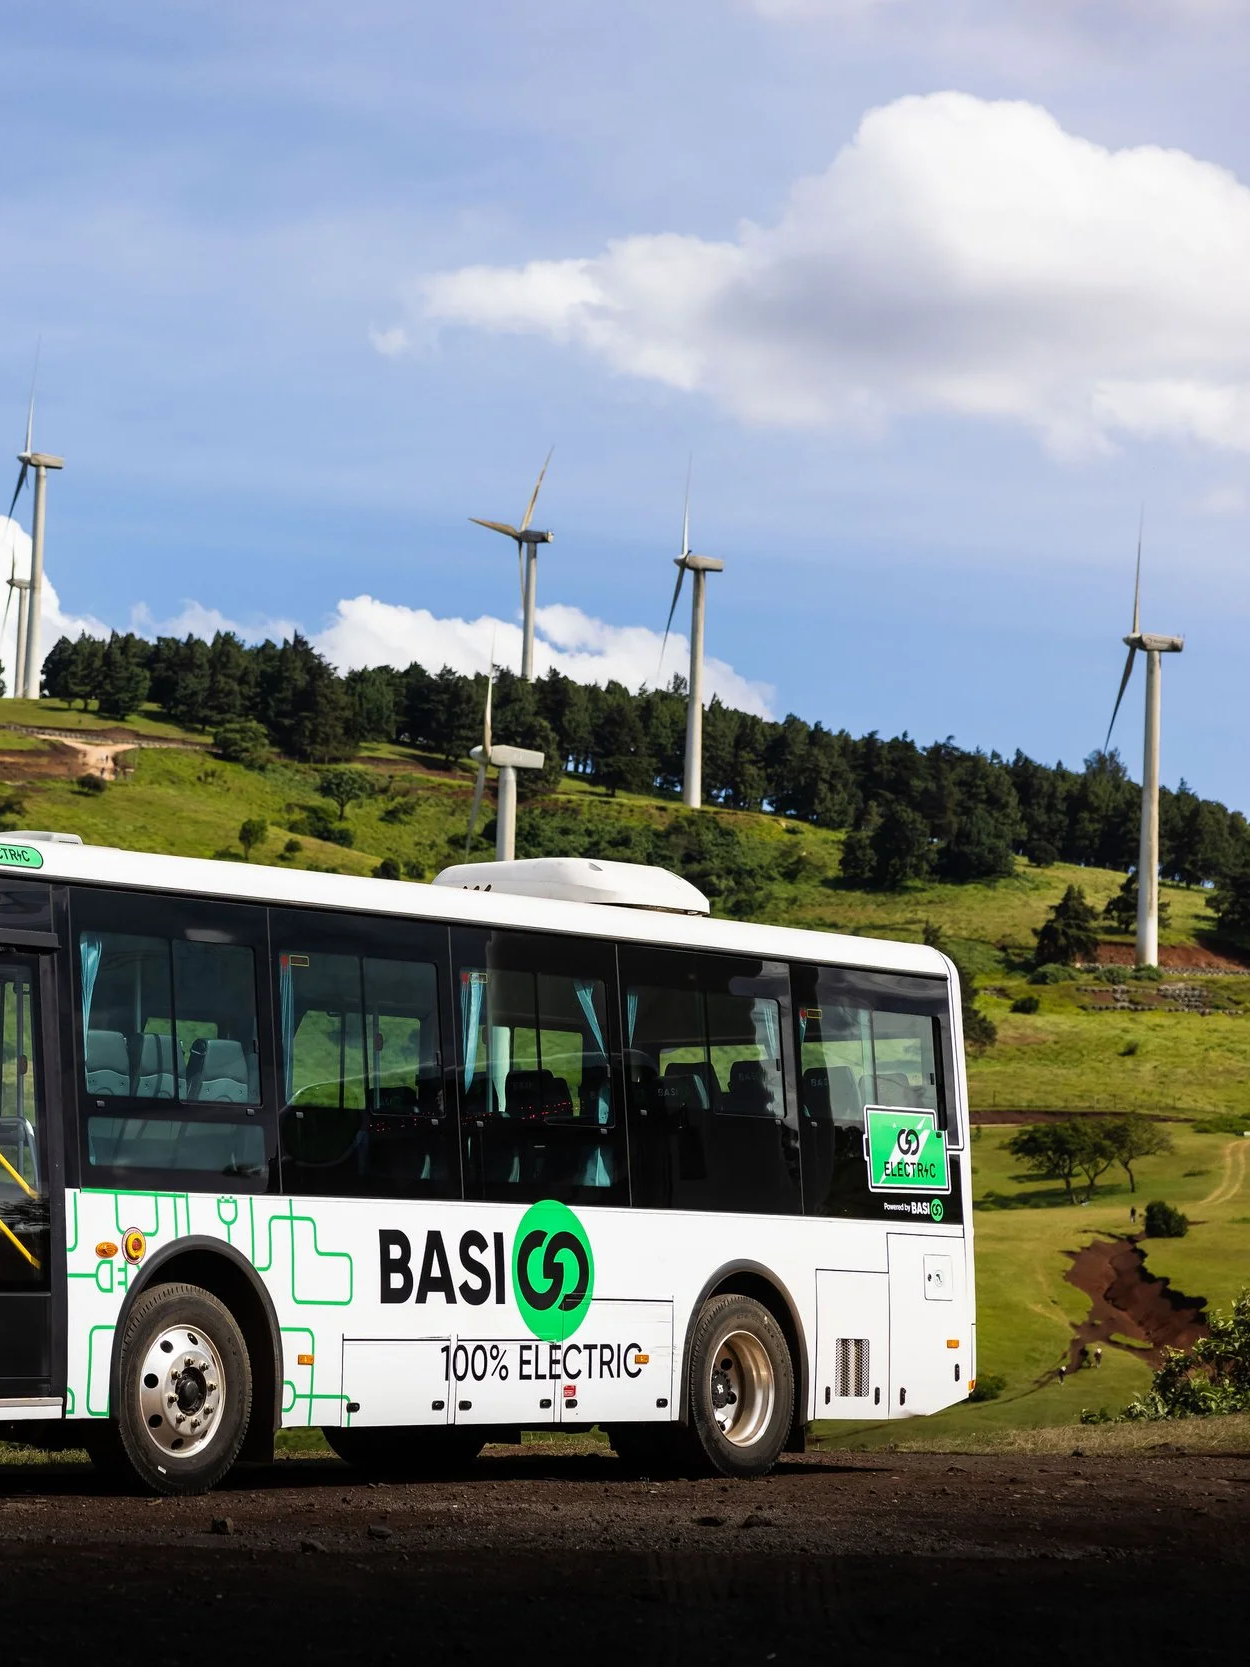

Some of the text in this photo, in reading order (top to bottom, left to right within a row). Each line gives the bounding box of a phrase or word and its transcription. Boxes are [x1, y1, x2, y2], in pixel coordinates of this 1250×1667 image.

[883, 1202, 904, 1211] Powered
[904, 1203, 911, 1213] by
[440, 1342, 643, 1382] 100% ELECTRIC
